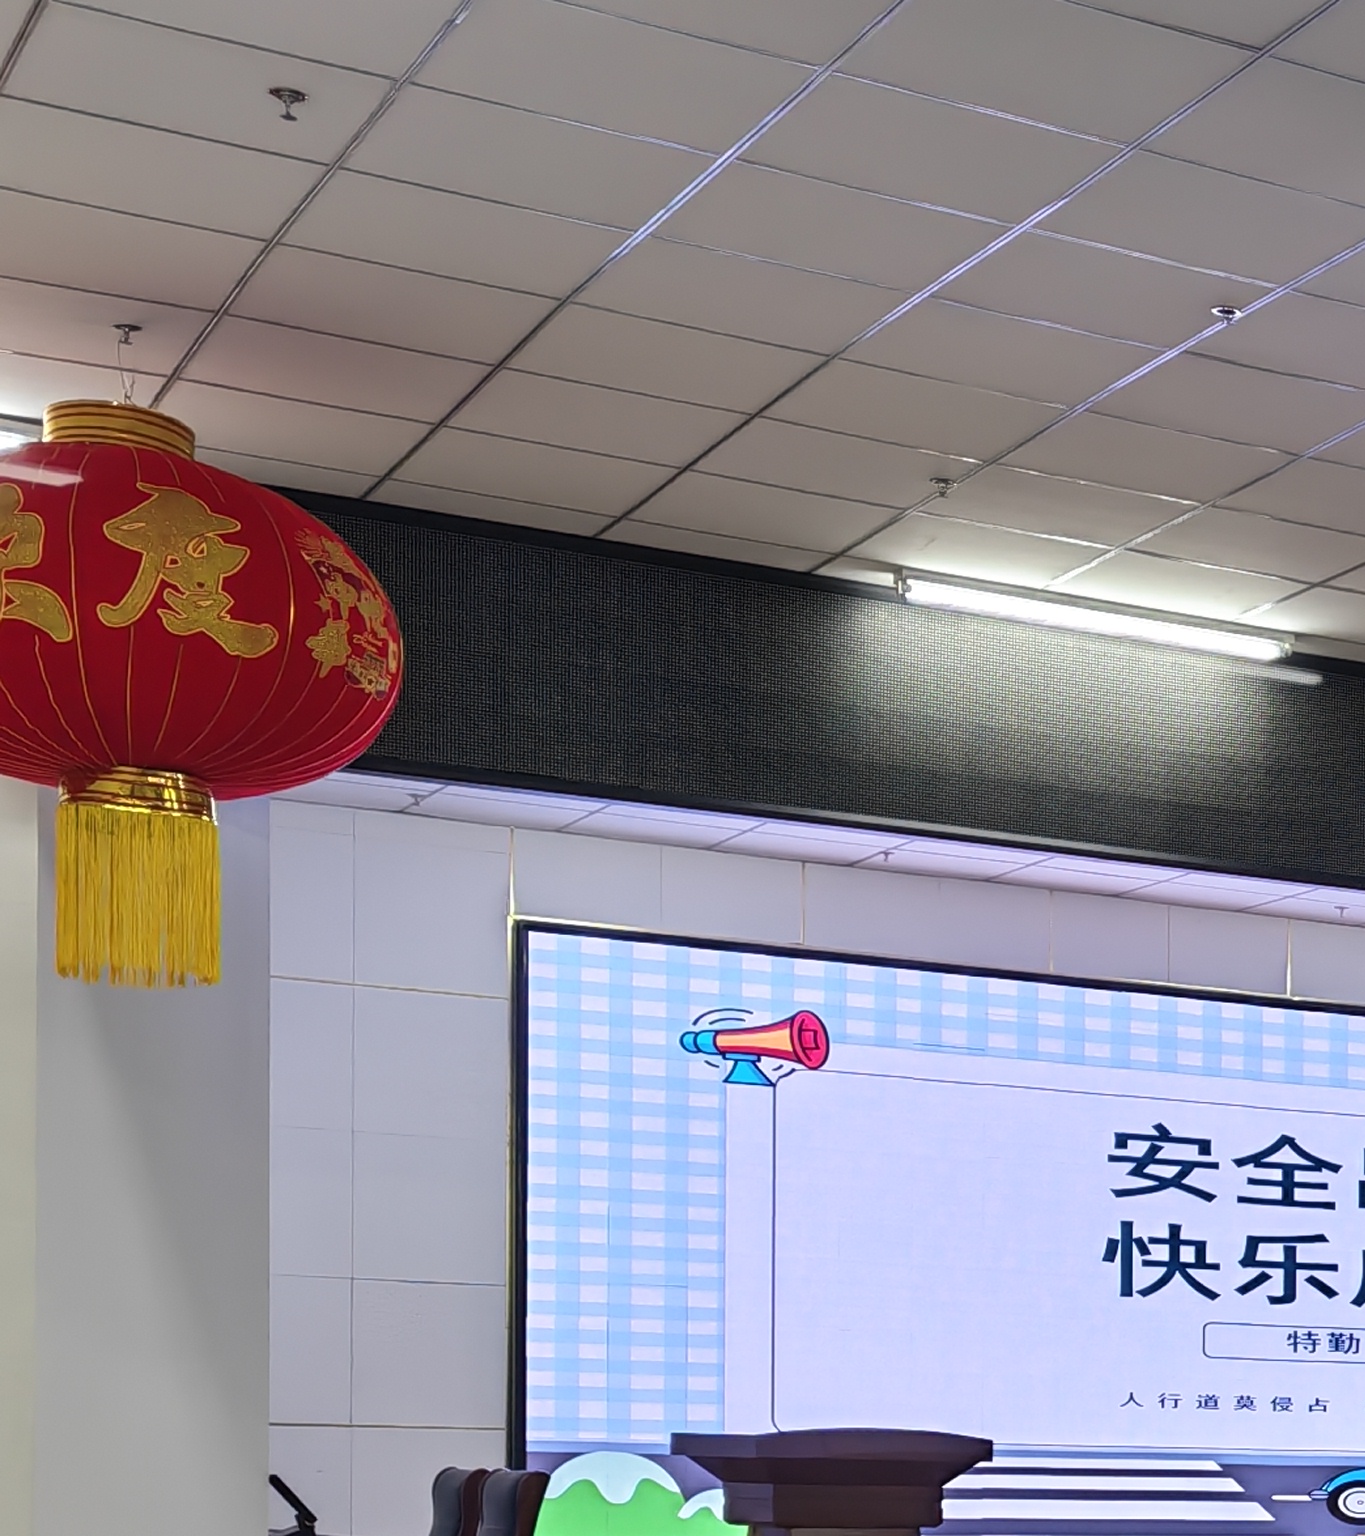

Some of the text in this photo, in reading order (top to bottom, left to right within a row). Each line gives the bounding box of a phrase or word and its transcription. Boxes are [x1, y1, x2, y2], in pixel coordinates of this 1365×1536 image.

[1120, 1391, 1330, 1414] 人行道莫侵占
